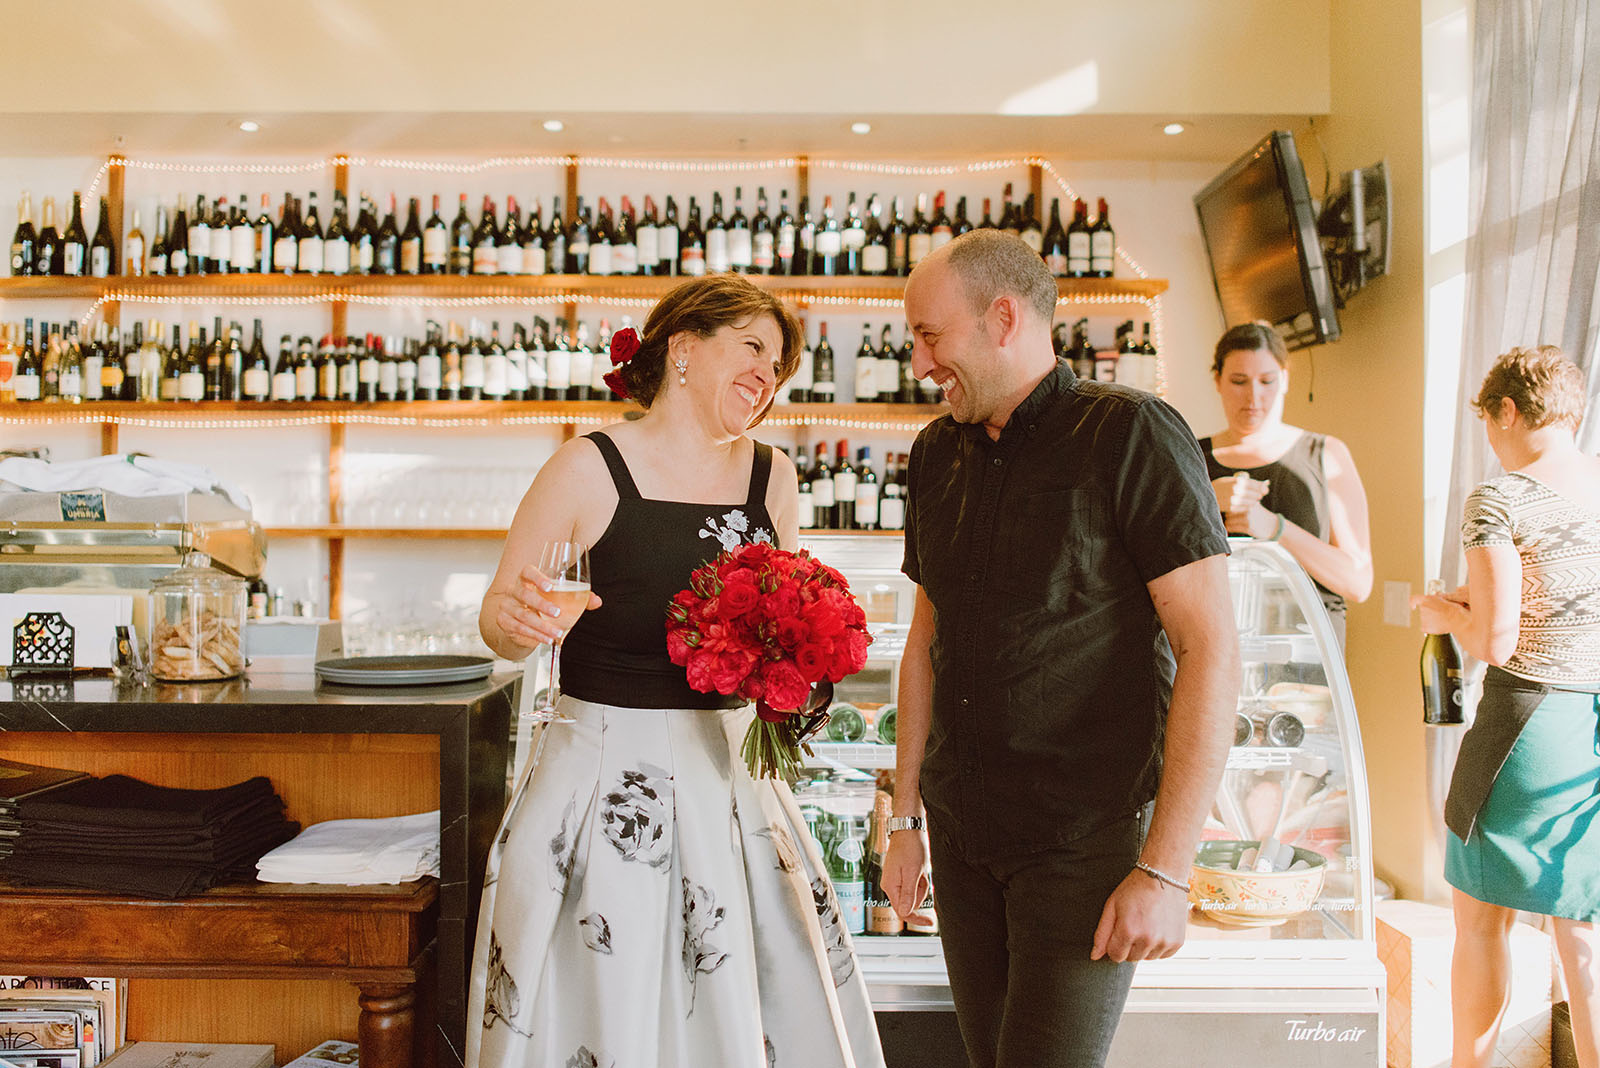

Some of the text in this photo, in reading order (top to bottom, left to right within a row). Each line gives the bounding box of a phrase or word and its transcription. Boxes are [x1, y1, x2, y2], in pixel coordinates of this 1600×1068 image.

[1199, 898, 1225, 911] Turbo
[1285, 1019, 1367, 1043] Turbo air
